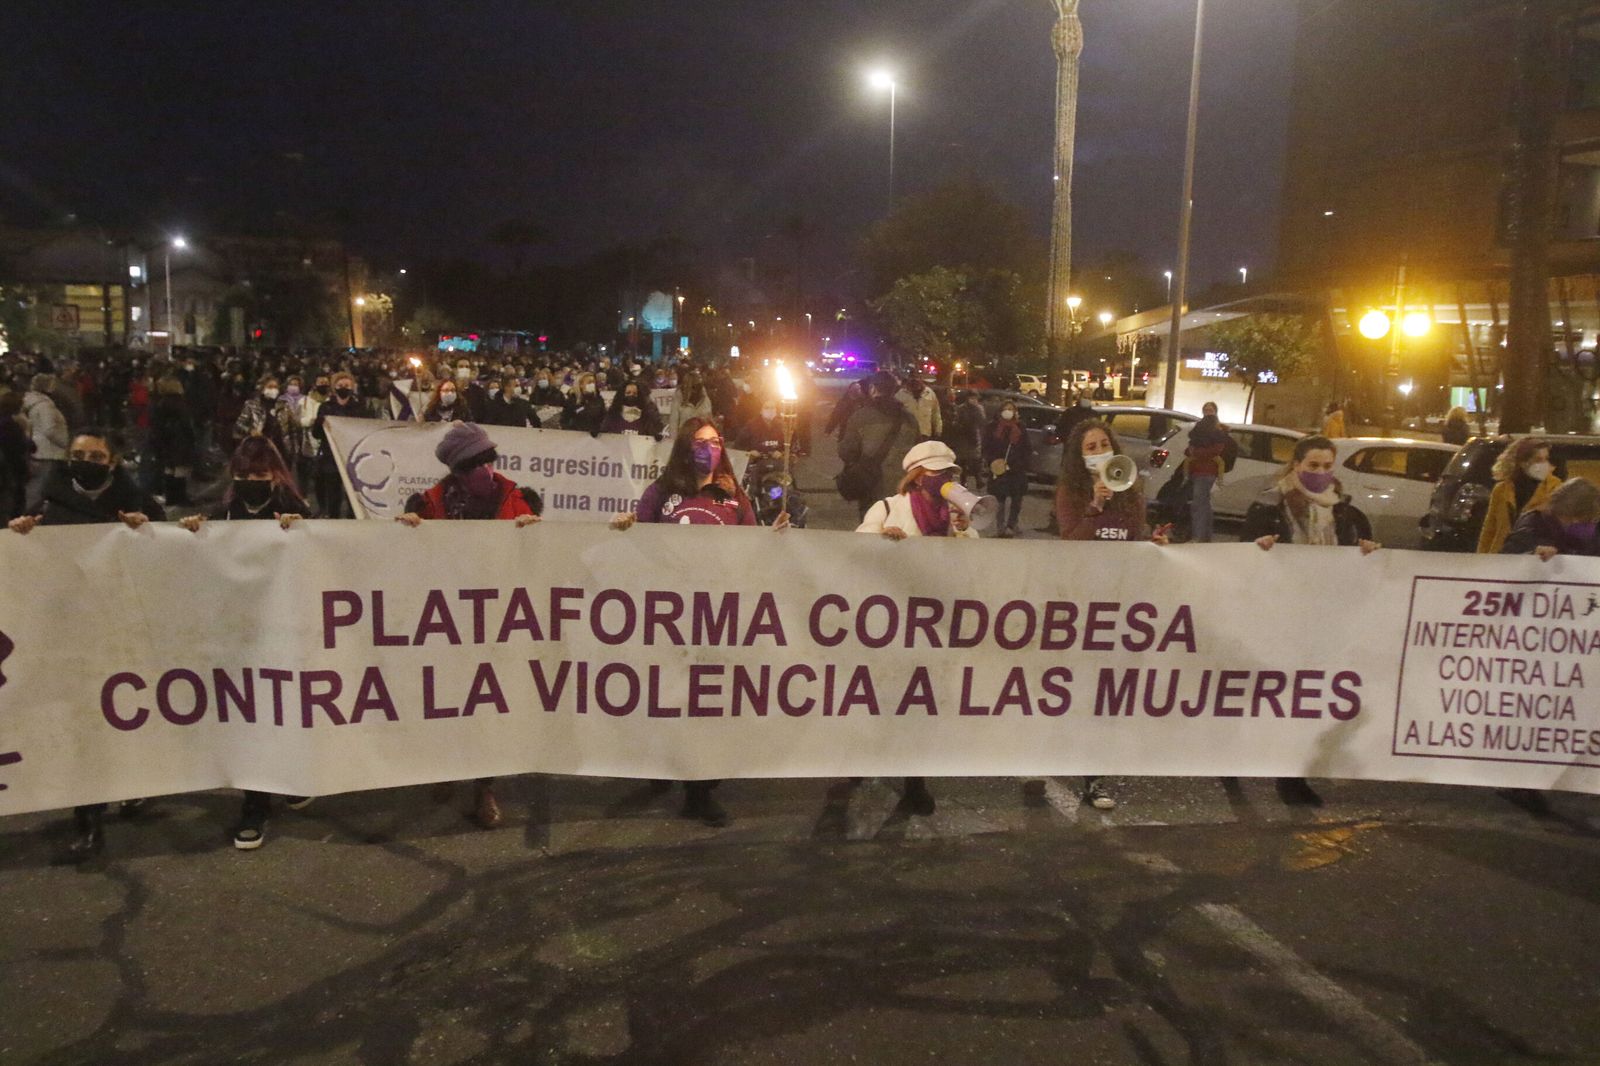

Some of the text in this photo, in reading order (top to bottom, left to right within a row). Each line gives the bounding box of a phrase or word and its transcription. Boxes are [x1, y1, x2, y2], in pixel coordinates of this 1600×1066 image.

[496, 455, 521, 470] na
[530, 456, 622, 477] agresión
[553, 494, 591, 511] una
[598, 497, 641, 513] mue
[1096, 528, 1128, 539] #25N
[322, 587, 1197, 653] PLATAFORMA CORDOBESA
[1462, 588, 1575, 620] 25N DÍA
[1413, 621, 1600, 655] INTERNACIONA
[1439, 655, 1584, 688] CONTRA LA
[101, 660, 1362, 731] CONTRA LA VIOLENCIA A LAS MUJERES
[1440, 688, 1576, 721] VIOLENCIA
[1404, 720, 1600, 756] A LAS MUJERES
